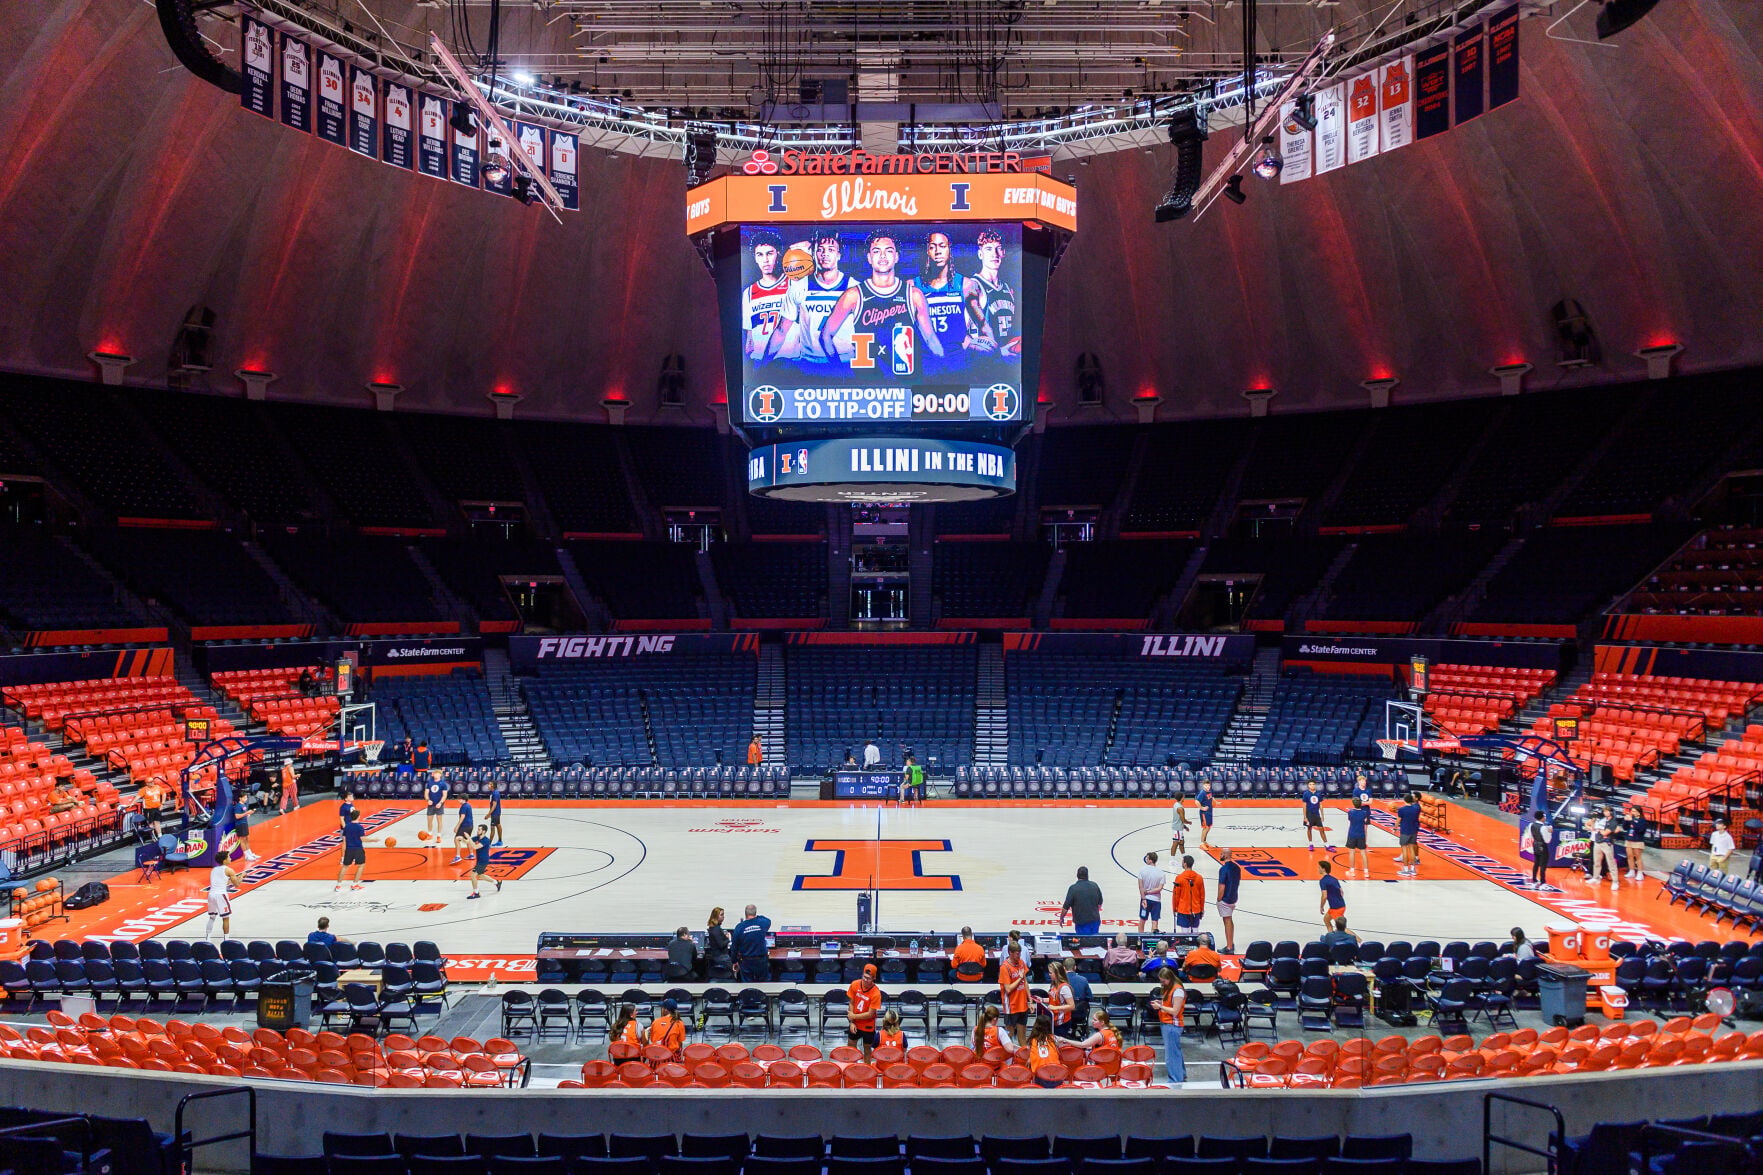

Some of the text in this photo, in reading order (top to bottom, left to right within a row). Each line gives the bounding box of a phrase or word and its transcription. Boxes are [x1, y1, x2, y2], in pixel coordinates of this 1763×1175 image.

[325, 77, 338, 91] 30
[1390, 82, 1401, 96] 13
[357, 91, 371, 106] 34
[1357, 95, 1369, 109] 32
[394, 106, 403, 118] 4
[1323, 107, 1336, 121] 24
[430, 118, 437, 128] 5
[527, 145, 535, 156] 21
[561, 153, 567, 163] 0
[916, 152, 1020, 174] CENTER
[820, 177, 919, 219] Illinois
[1003, 187, 1077, 217] EVERY DAY GUYS
[690, 197, 711, 220] GUYS
[751, 300, 782, 314] wizard
[861, 303, 908, 326] Clippers
[760, 311, 779, 336] 27
[931, 316, 949, 333] 13
[794, 388, 906, 401] COUNTDOWN
[794, 401, 906, 419] TO TIP-OFF
[912, 393, 970, 413] 90:00
[851, 448, 1004, 478] ILLINI IN THE NBA
[537, 635, 677, 659] FIGHTING
[1140, 636, 1228, 657] ILLINI
[1350, 647, 1377, 655] CENTER
[188, 721, 207, 730] 90:00
[1556, 720, 1577, 728] 90:00
[870, 776, 890, 784] 90:00
[1563, 936, 1575, 949] G
[1595, 936, 1608, 949] G
[857, 999, 865, 1012] 4
